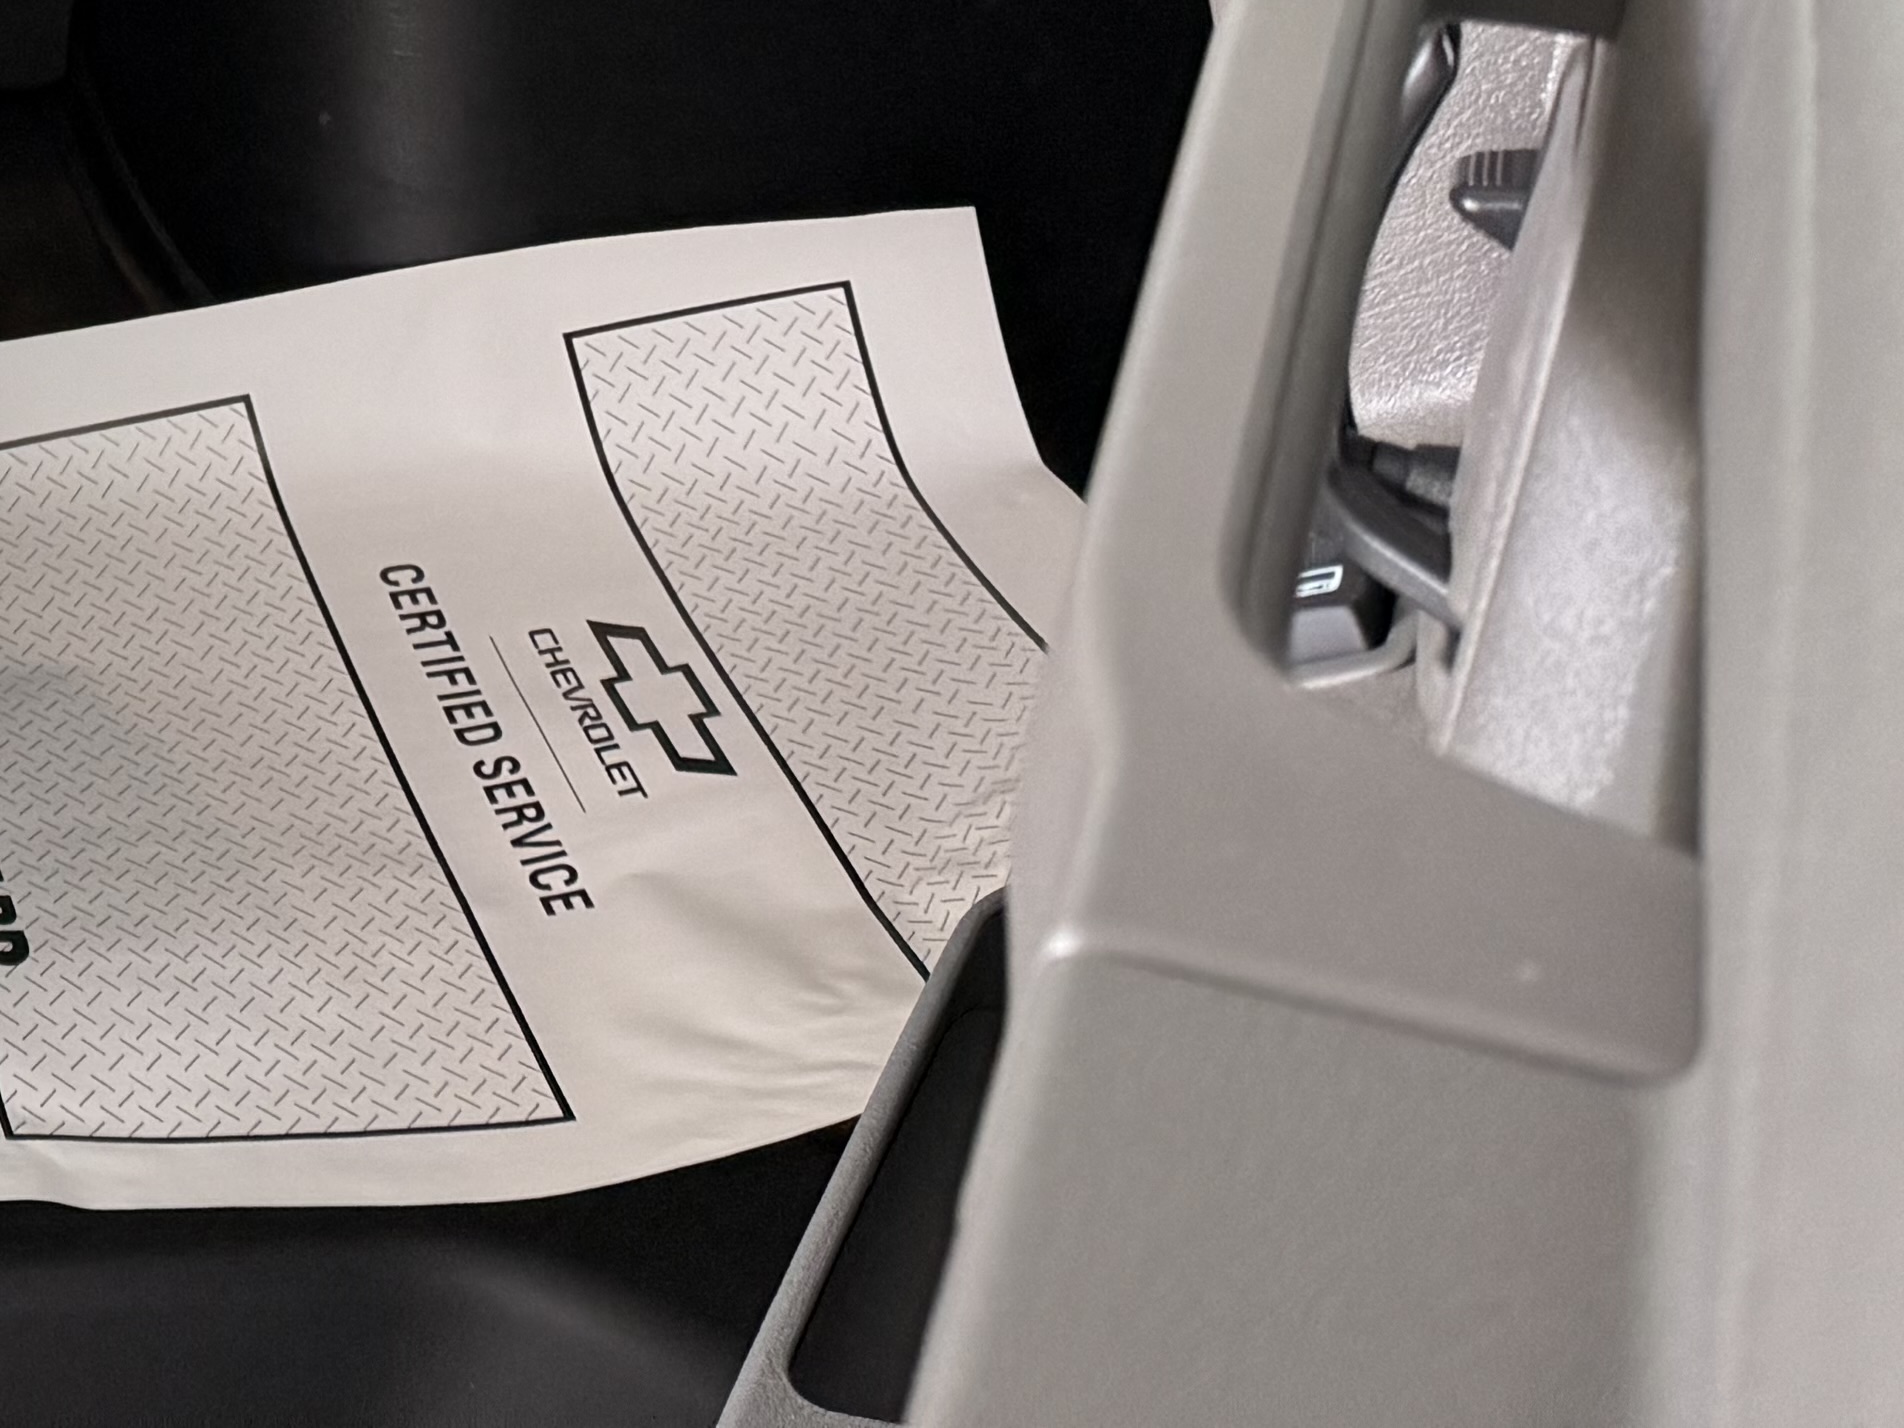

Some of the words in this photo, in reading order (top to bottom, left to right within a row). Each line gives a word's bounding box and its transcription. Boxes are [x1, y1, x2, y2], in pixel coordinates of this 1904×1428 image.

[379, 564, 503, 746] CERTIFIED
[472, 755, 595, 916] SERVICE
[528, 627, 648, 799] CHEVROLET
